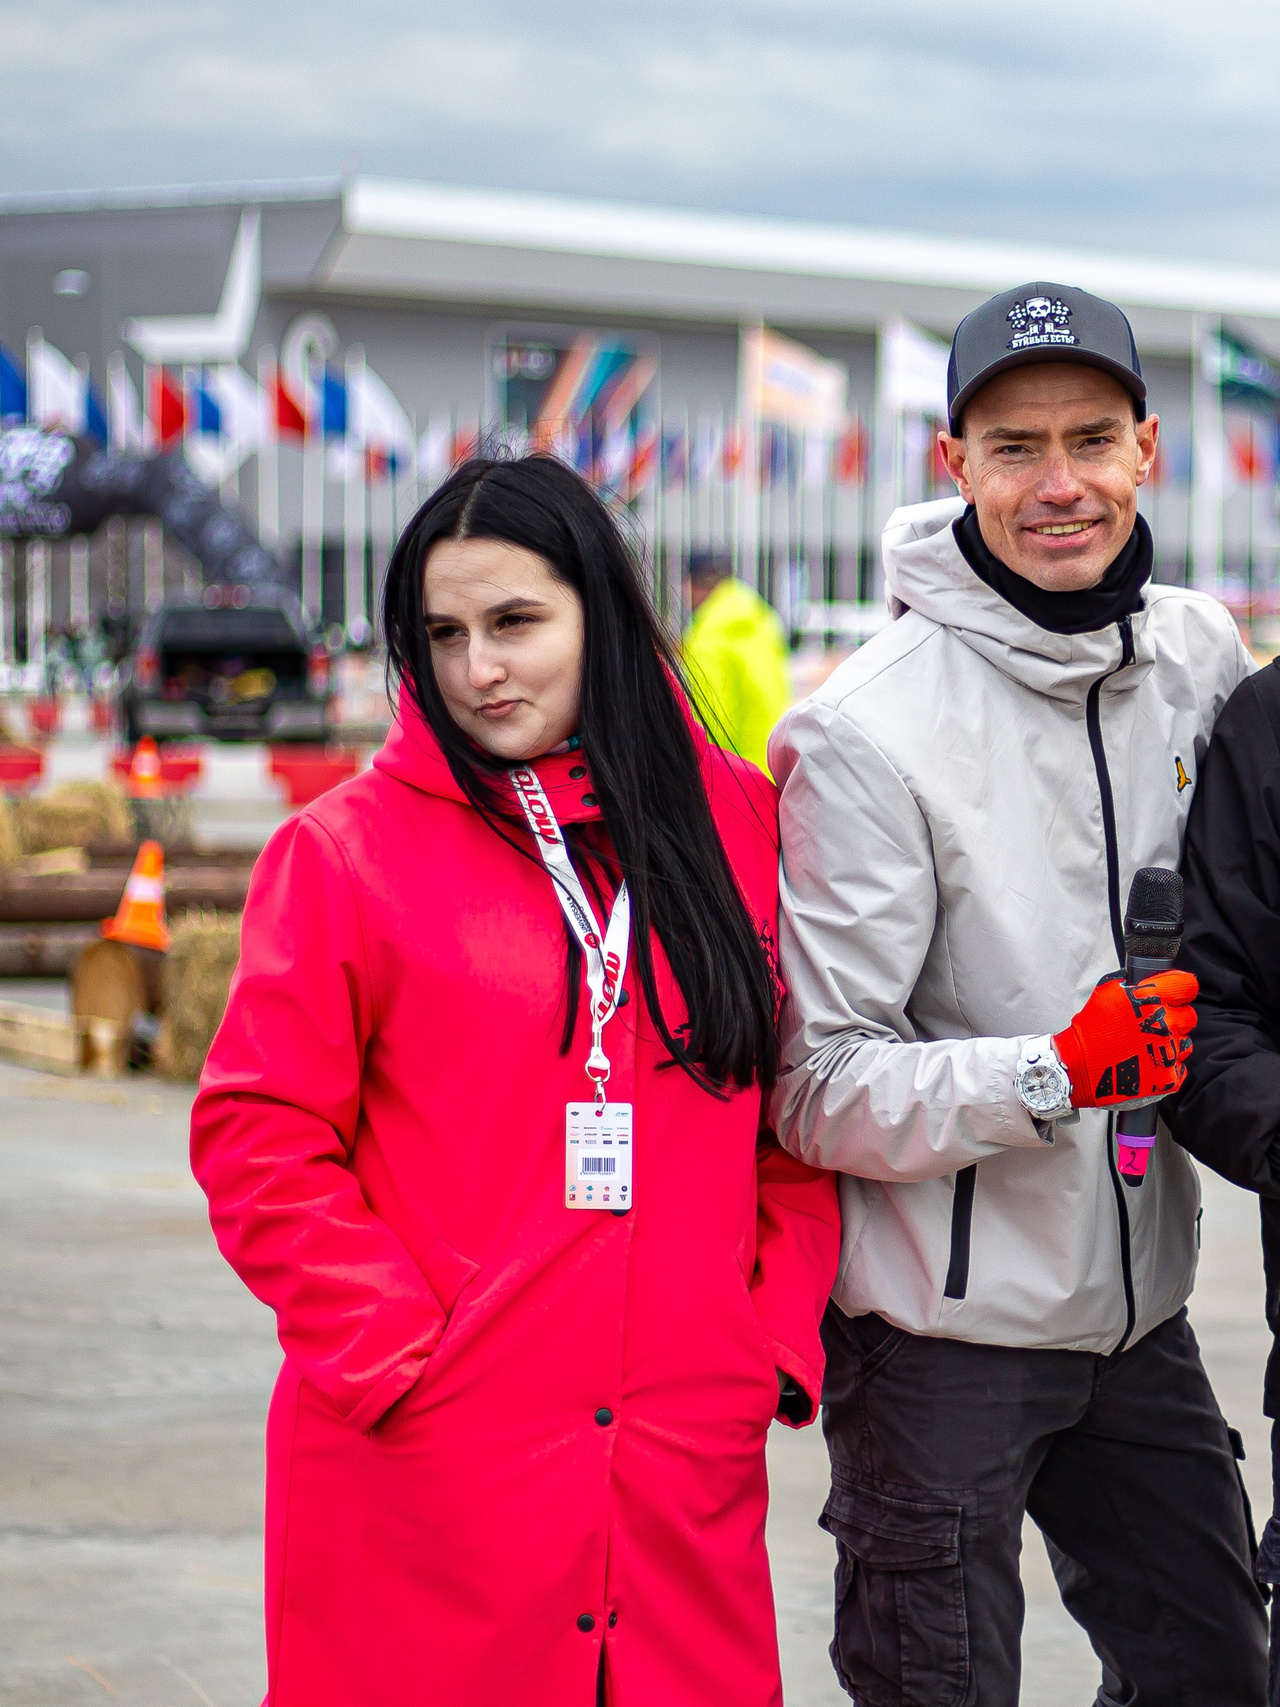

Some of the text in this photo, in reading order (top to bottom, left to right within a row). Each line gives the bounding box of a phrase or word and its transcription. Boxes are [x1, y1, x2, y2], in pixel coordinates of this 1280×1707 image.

[1012, 334, 1075, 349] БУЙНЫЕ ЕСТЬ?
[1125, 1150, 1140, 1171] 2
